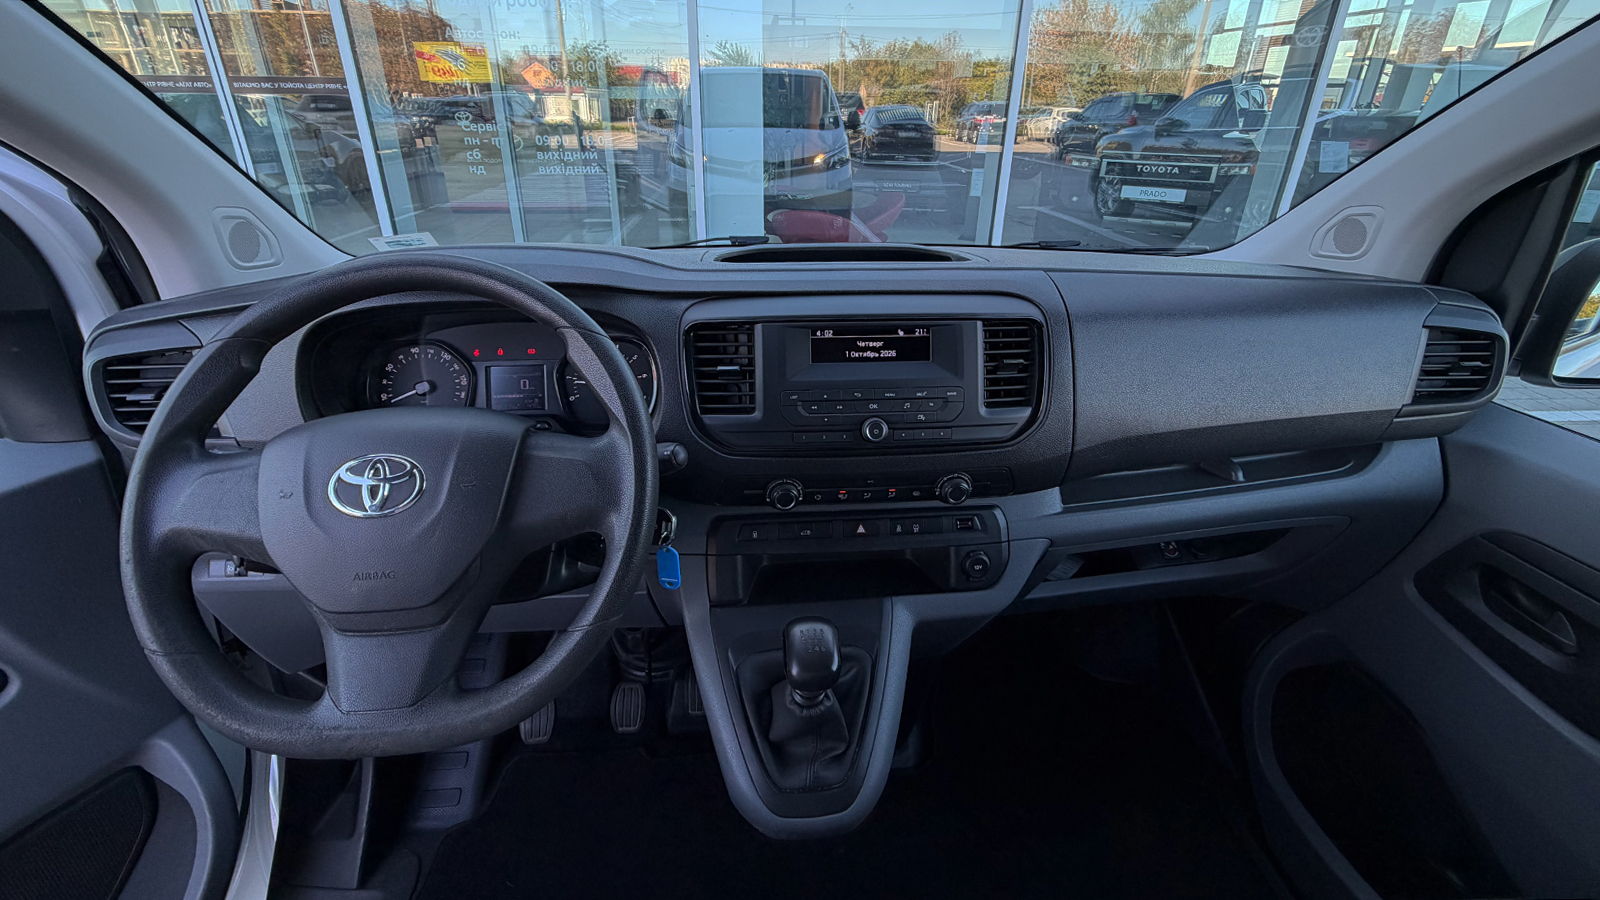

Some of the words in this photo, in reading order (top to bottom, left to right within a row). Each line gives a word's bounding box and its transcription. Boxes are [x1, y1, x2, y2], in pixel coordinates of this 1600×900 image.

[537, 148, 598, 161] вихідний
[469, 165, 486, 175] нд
[539, 164, 600, 176] вихідний
[1136, 165, 1179, 174] TOYOTA
[1139, 189, 1167, 198] PRADO
[851, 351, 879, 359] Октябрь
[353, 570, 396, 581] AIRBAG
